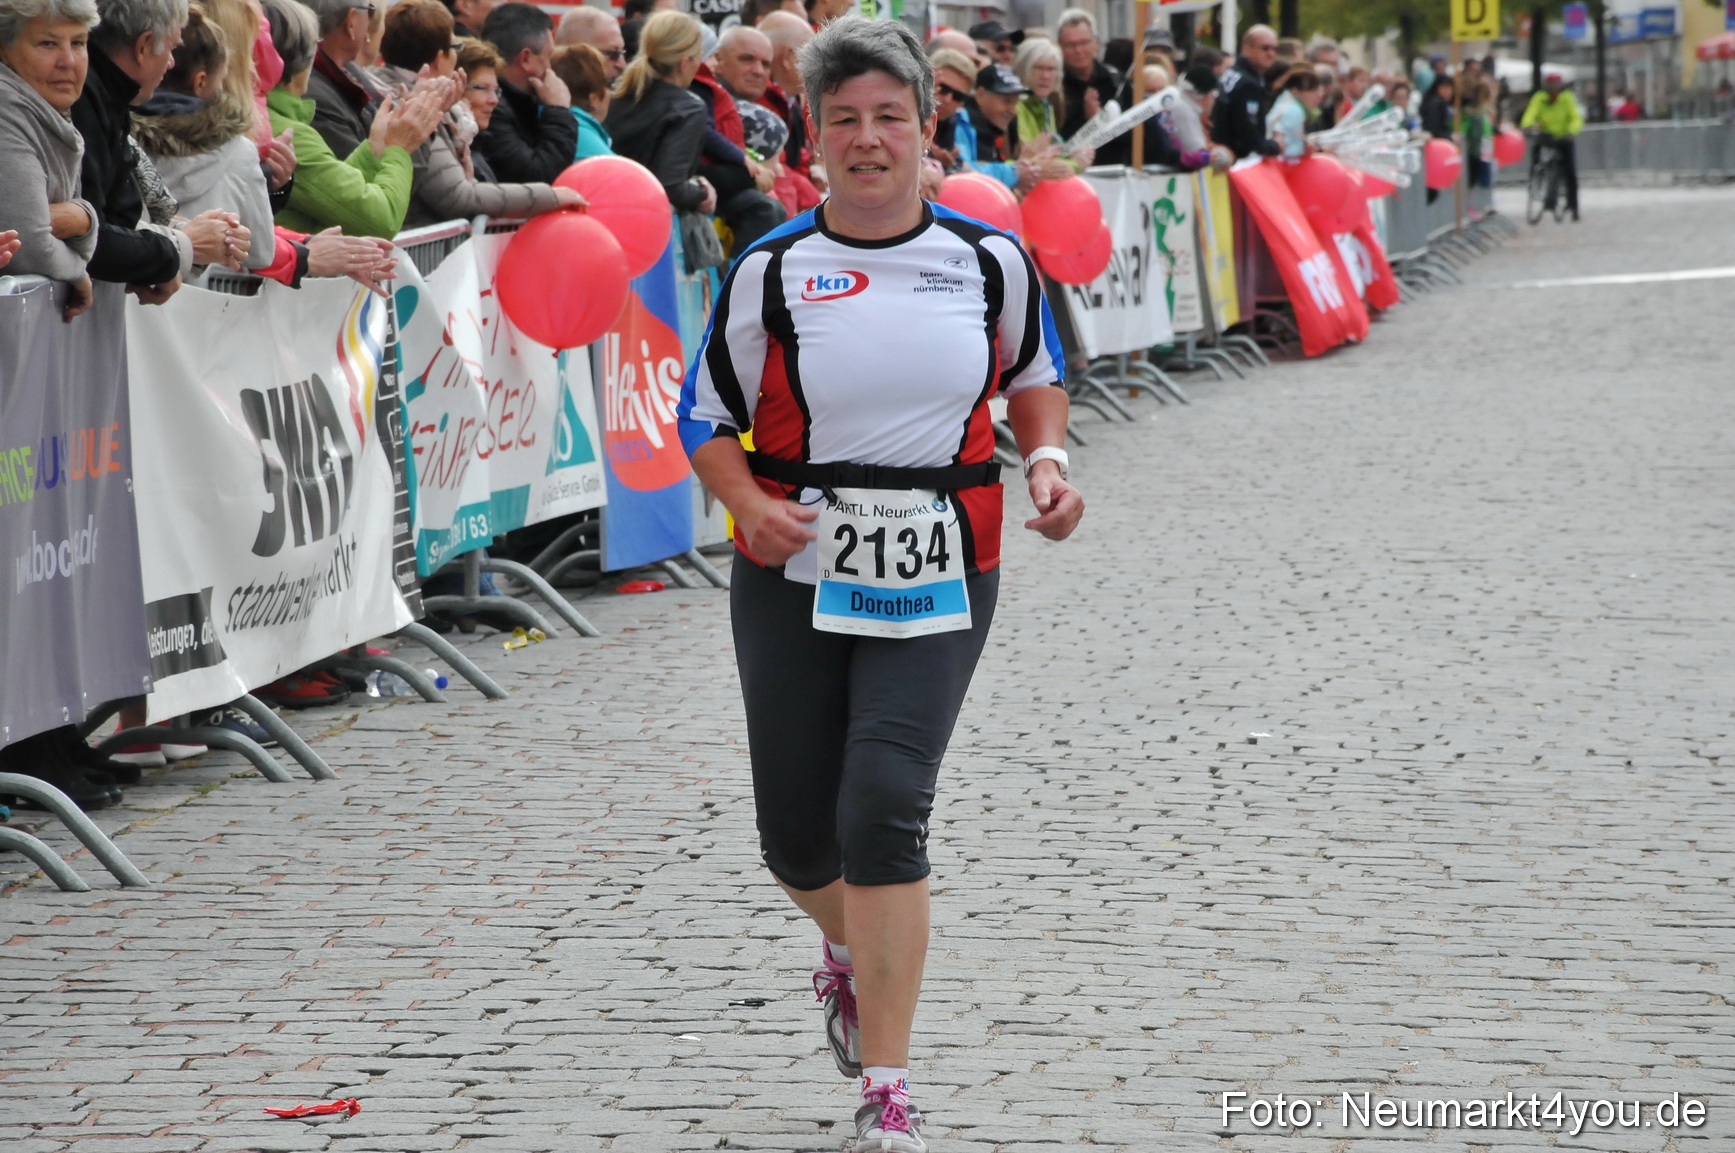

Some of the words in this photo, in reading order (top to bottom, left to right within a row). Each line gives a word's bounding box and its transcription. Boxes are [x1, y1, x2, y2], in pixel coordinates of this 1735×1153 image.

[804, 275, 850, 292] tkn
[926, 278, 963, 286] klinikum
[913, 285, 954, 294] nürnberg
[833, 521, 950, 580] 2134
[824, 569, 831, 579] D
[851, 591, 935, 617] Dorothea
